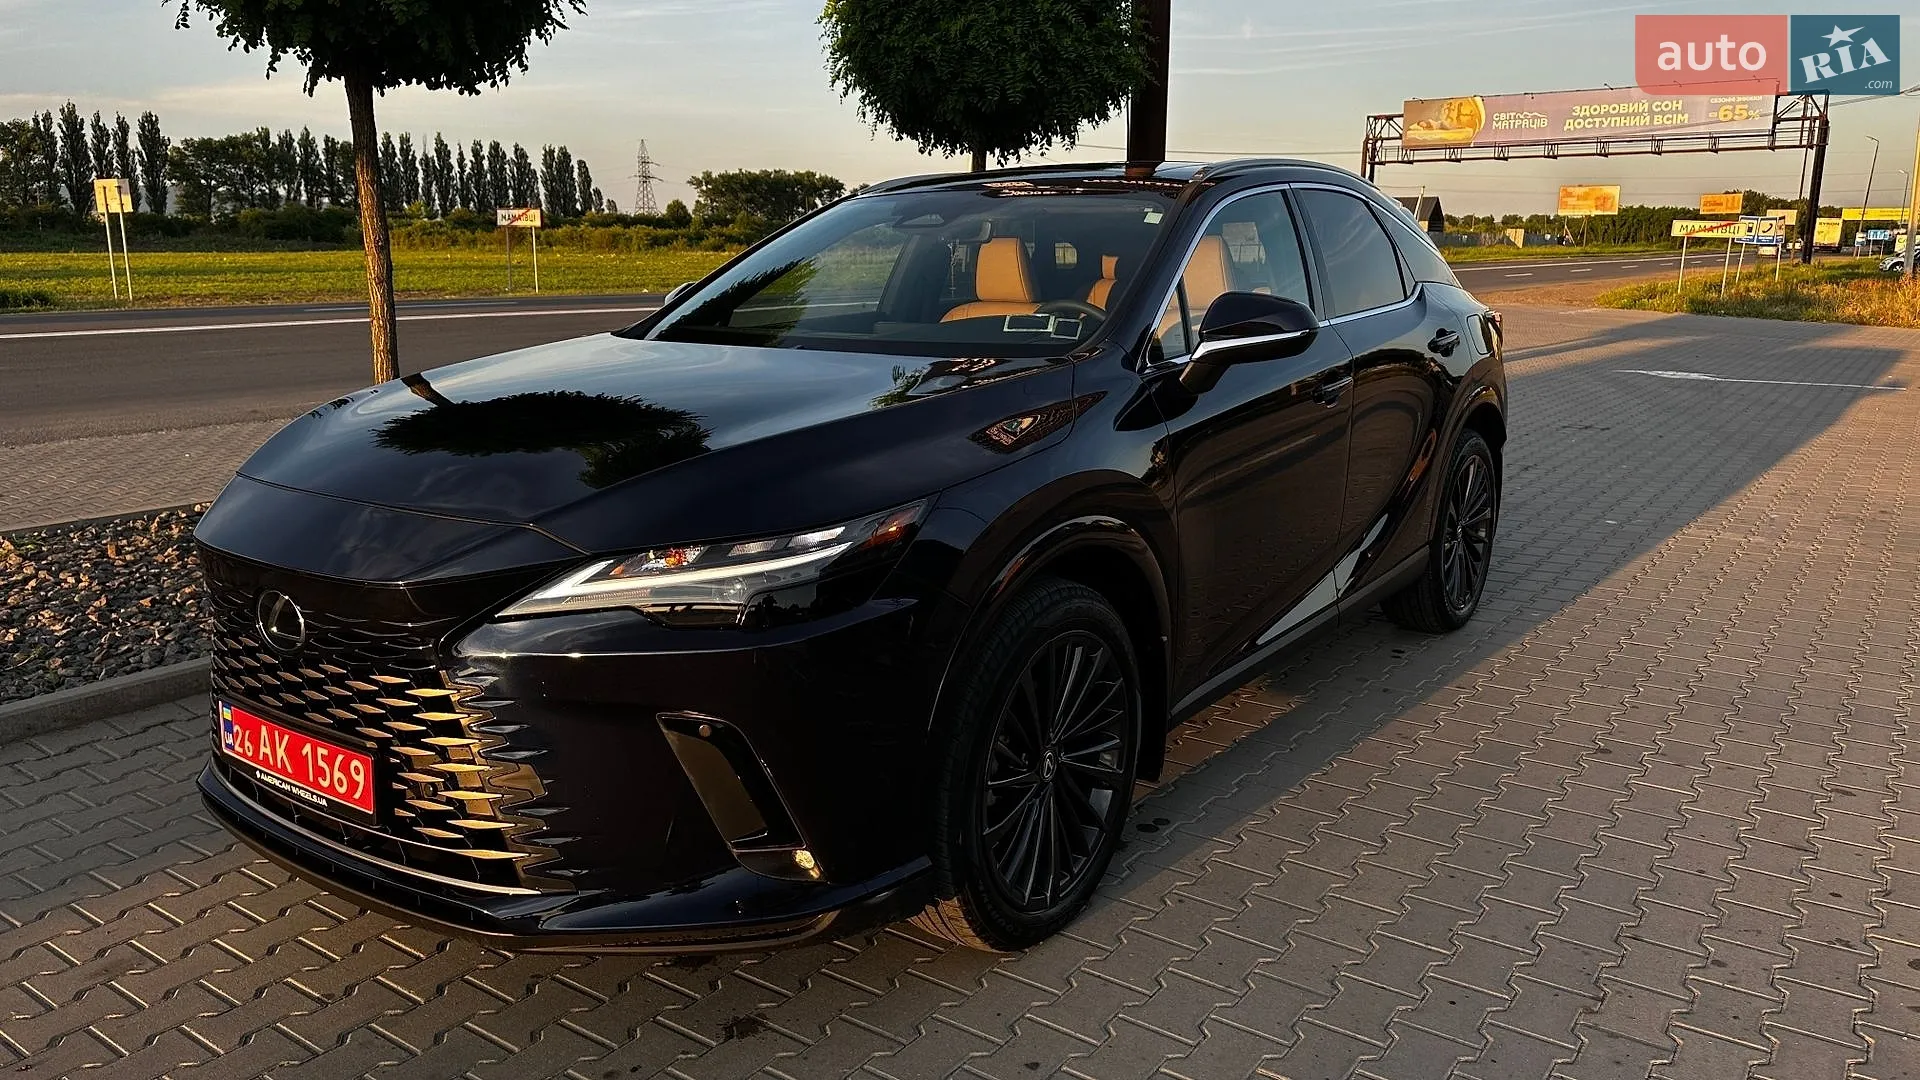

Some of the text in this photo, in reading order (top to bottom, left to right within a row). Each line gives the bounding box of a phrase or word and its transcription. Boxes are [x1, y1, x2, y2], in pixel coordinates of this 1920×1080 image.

[1492, 112, 1517, 120] СВІТ
[1572, 99, 1683, 117] ЗДОРОВИЙ СОН
[1492, 118, 1548, 129] МАТРАЦІВ
[1563, 113, 1689, 131] ДОСТУПНИЙ ВСІМ
[224, 731, 234, 746] UA
[233, 724, 366, 800] 26 AK 1569
[260, 772, 328, 807] AMERICAN WHEELS.UA
